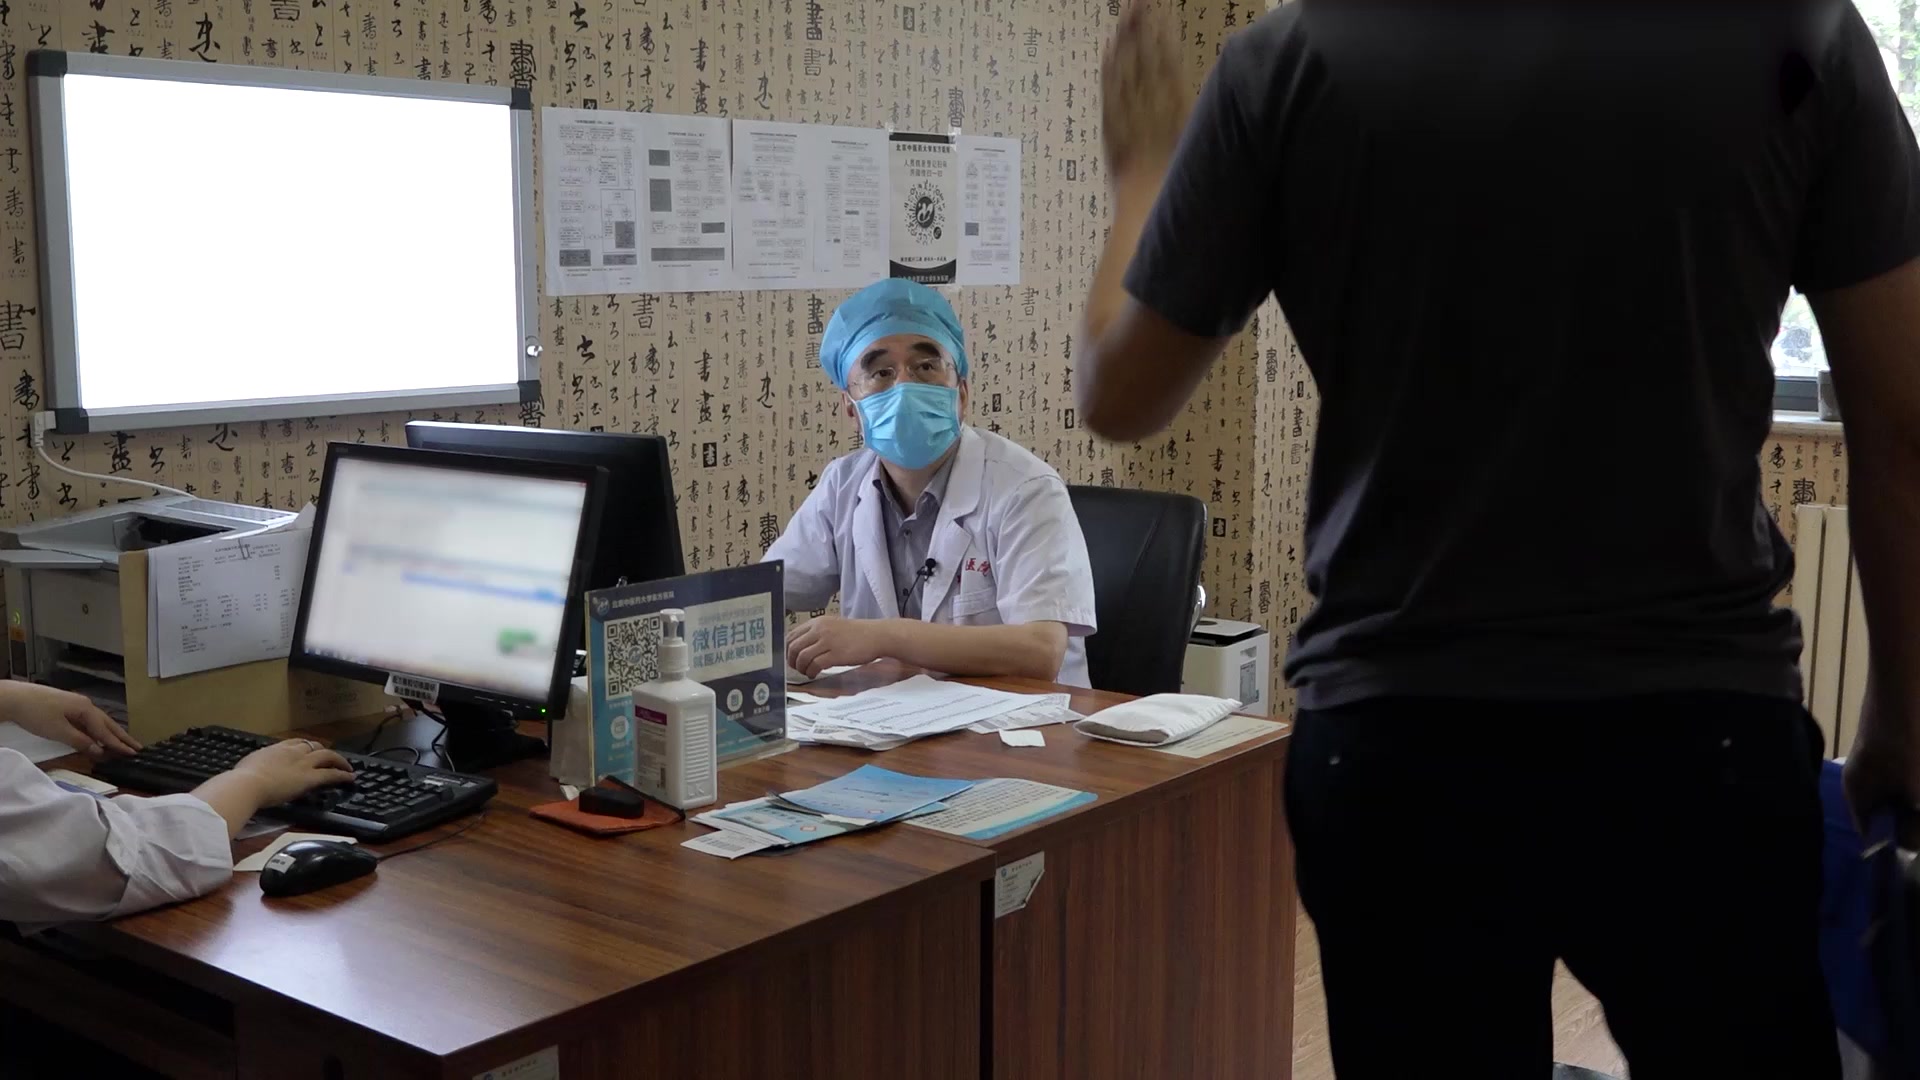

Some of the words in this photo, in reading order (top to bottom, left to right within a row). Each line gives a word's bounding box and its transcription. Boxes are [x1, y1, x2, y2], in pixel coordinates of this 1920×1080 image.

[692, 617, 766, 653] 微信扫码
[693, 642, 766, 668] 就医从此更轻松
